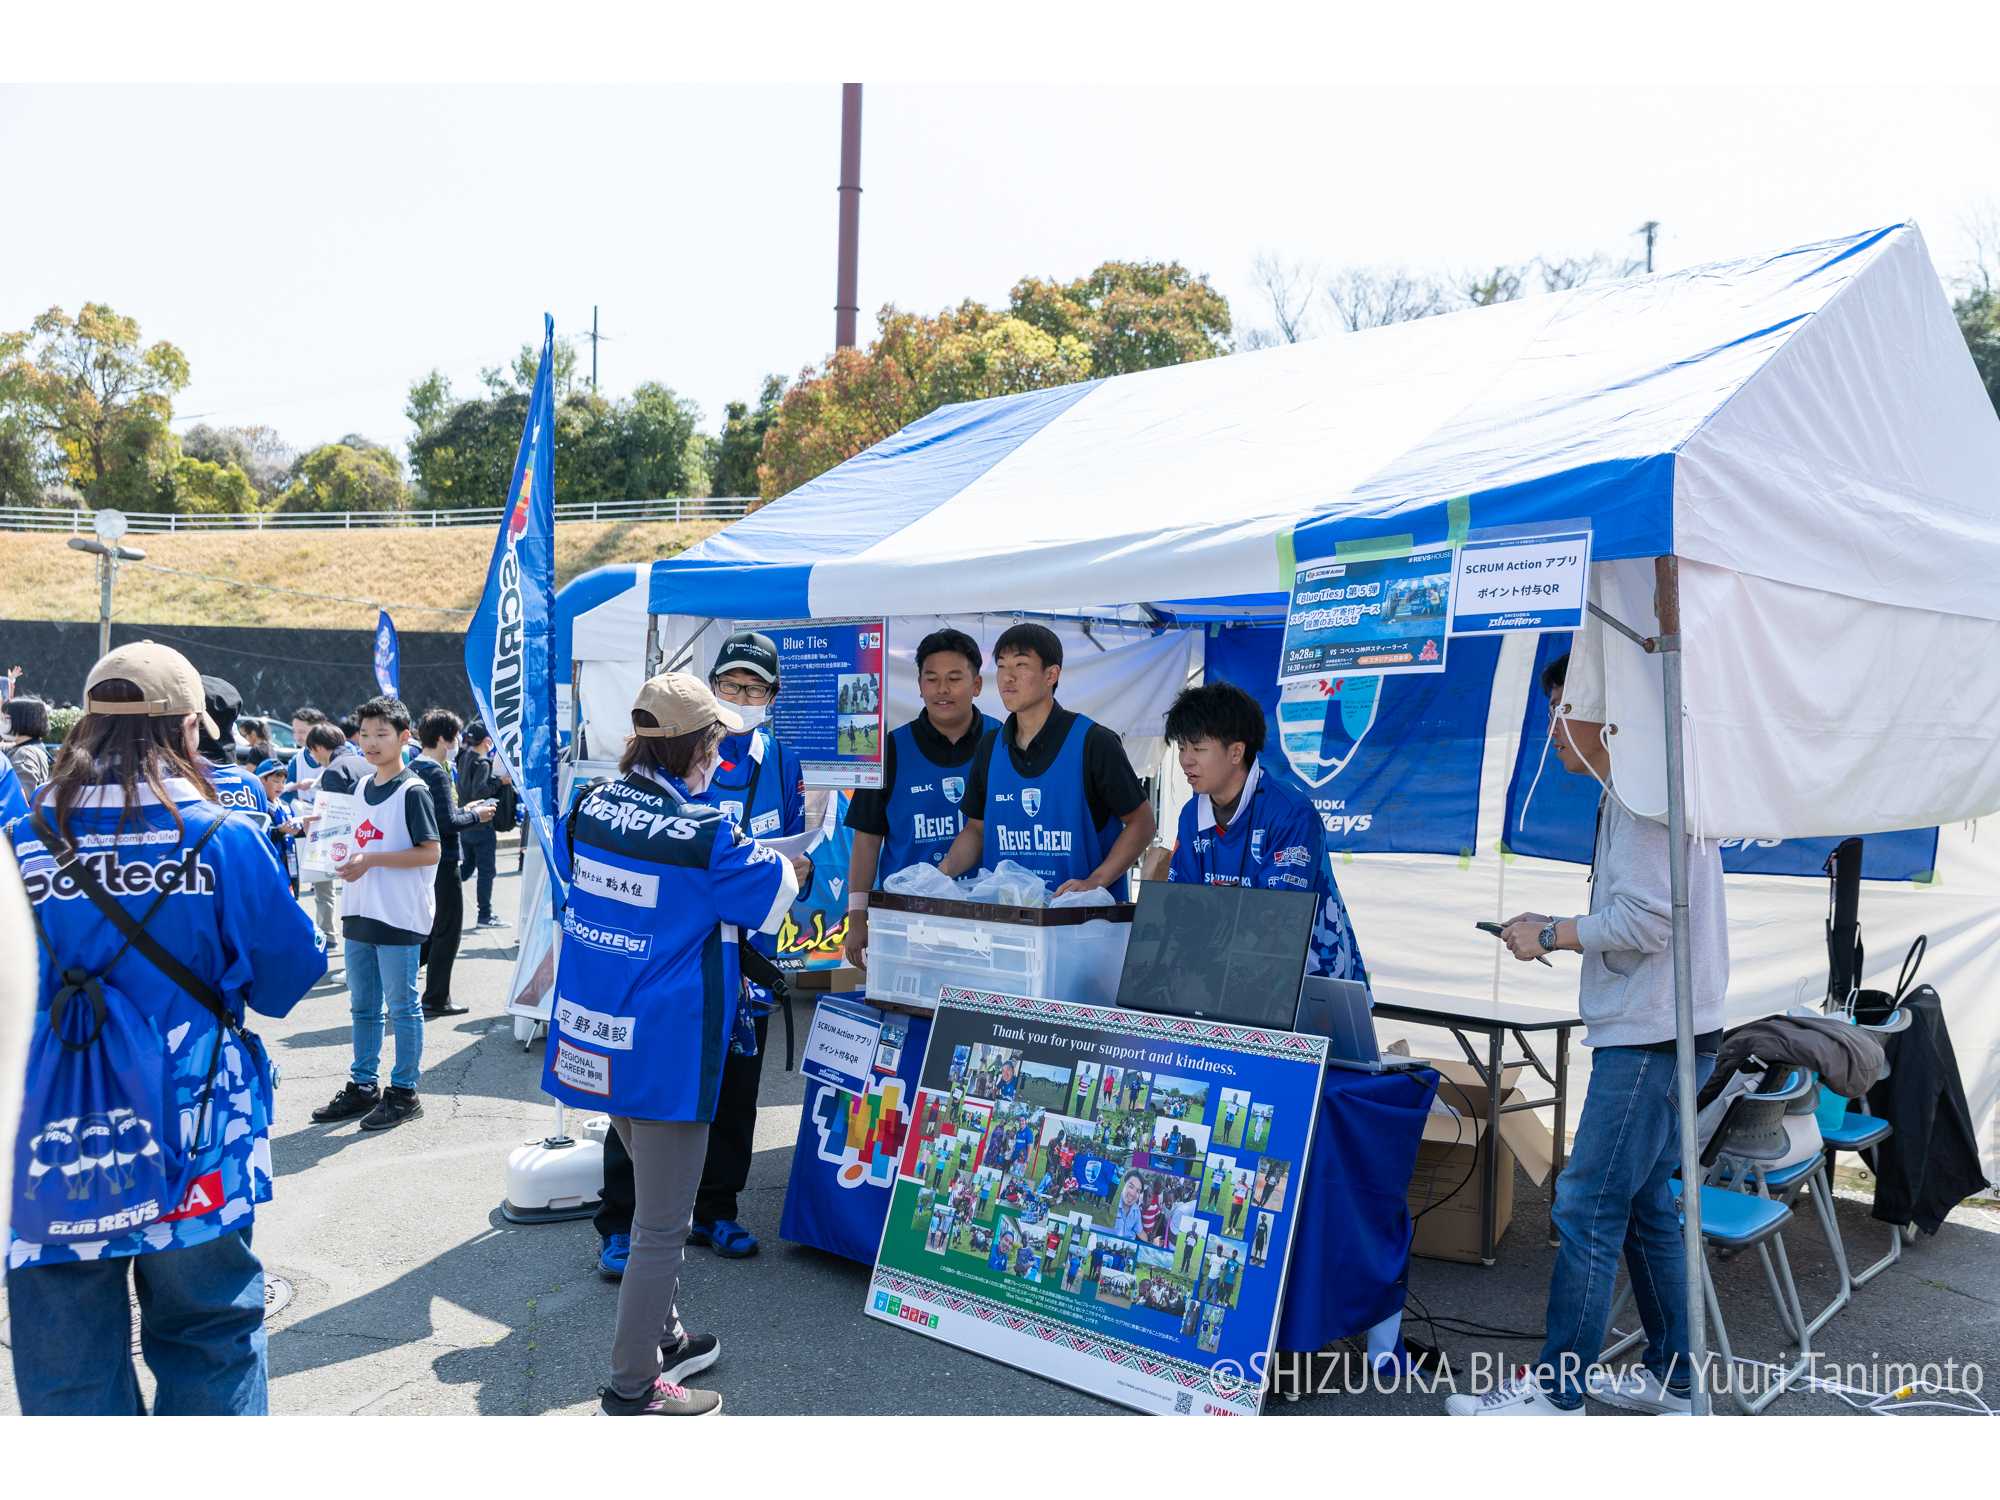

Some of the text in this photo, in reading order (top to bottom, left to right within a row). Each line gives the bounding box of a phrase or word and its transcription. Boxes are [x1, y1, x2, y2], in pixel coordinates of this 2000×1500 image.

[1466, 556, 1577, 574] SCRUM Action アプリ
[1478, 584, 1559, 599] ポイント付与QR
[783, 637, 804, 650] Blue
[806, 635, 828, 649] Ties
[911, 783, 934, 794] BLK
[995, 793, 1014, 802] BLK
[579, 785, 701, 840] ueRevs
[1311, 800, 1345, 810] UOKA
[914, 813, 955, 840] REVS
[996, 823, 1072, 852] REVS CREW
[558, 1009, 628, 1042] 平野建設
[817, 1021, 872, 1047] SCRUM Action アプリ
[561, 1048, 596, 1069] REGIONAL
[992, 1023, 1237, 1076] Thank you for your support and kindness.
[560, 1059, 586, 1077] CAREER
[48, 1222, 96, 1235] CLUB
[98, 1201, 160, 1233] REVS
[1212, 1406, 1243, 1416] YAMA
